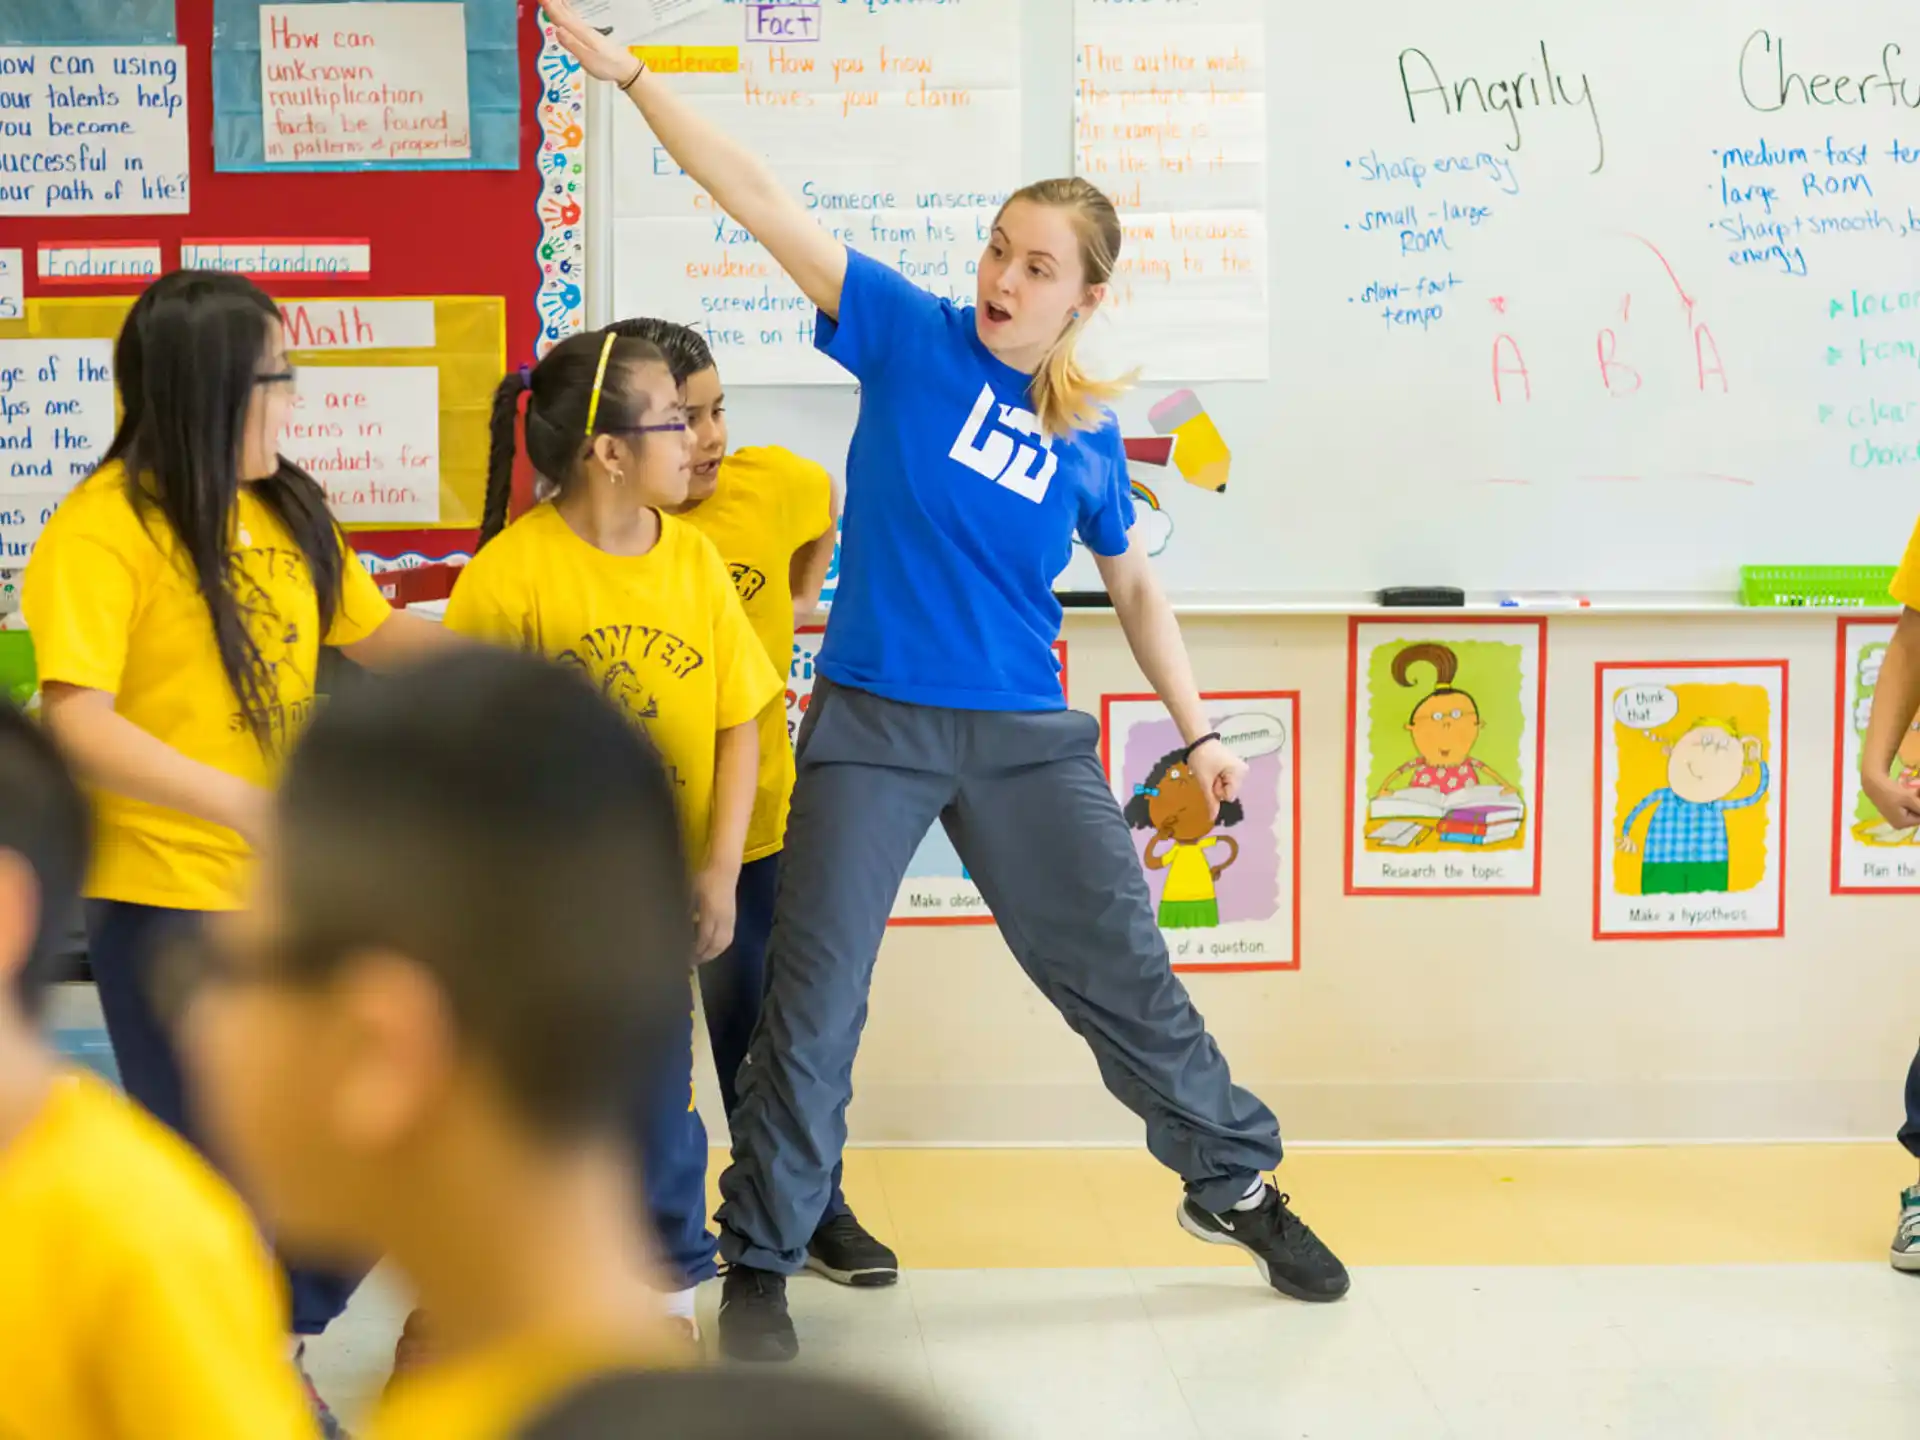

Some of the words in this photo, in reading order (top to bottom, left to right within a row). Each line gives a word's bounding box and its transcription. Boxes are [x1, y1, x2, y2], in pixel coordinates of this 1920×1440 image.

[271, 14, 319, 49] How
[334, 31, 374, 47] can
[757, 6, 812, 35] Fact
[0, 54, 35, 75] ow
[50, 55, 94, 74] can
[113, 57, 177, 84] using
[267, 58, 374, 82] unknown
[769, 45, 815, 73] How
[831, 57, 864, 83] you
[880, 44, 932, 73] know
[1084, 45, 1123, 72] The
[1133, 45, 1196, 72] author
[1739, 29, 1920, 112] Cheerfu
[0, 92, 33, 108] our
[45, 83, 119, 108] talents
[137, 83, 182, 118] help
[268, 83, 423, 115] multiplication
[842, 89, 879, 117] your
[905, 79, 970, 106] claim
[1398, 40, 1604, 174] Angrily
[48, 113, 135, 136] become
[273, 108, 327, 135] facts
[341, 113, 368, 133] be
[384, 106, 448, 131] found
[125, 156, 143, 171] in
[1434, 152, 1520, 195] energy
[0, 184, 35, 200] our
[46, 178, 94, 207] path
[105, 179, 123, 200] of
[142, 172, 188, 200] life?
[802, 181, 895, 210] Someone
[1109, 179, 1141, 207] aid
[1721, 175, 1780, 215] large
[1803, 172, 1873, 197] ROM
[870, 215, 915, 242] from
[926, 216, 955, 242] his
[1400, 226, 1452, 256] ROM
[48, 249, 154, 283] Enduring
[184, 246, 350, 277] Understandings
[685, 250, 768, 278] evidence
[898, 249, 948, 276] found
[1728, 245, 1808, 276] energy
[279, 305, 374, 346] Math
[1382, 304, 1443, 331] tempo
[704, 318, 744, 349] tire
[760, 329, 782, 344] on
[0, 367, 26, 392] ge
[38, 354, 61, 382] of
[78, 357, 110, 382] the
[1492, 333, 1530, 404] A
[1598, 328, 1642, 397] B
[1694, 323, 1728, 393] A
[0, 395, 30, 424] lps
[45, 399, 83, 415] one
[325, 392, 367, 409] are
[0, 425, 32, 449] and
[52, 426, 92, 449] the
[285, 421, 343, 438] terns
[358, 422, 383, 437] in
[11, 458, 53, 477] and
[399, 444, 432, 468] for
[1636, 689, 1664, 706] think
[1382, 862, 1436, 879] Research
[1444, 864, 1464, 879] the
[1863, 861, 1889, 878] Plan
[1897, 861, 1917, 878] the
[910, 893, 942, 908] Make
[949, 893, 987, 908] obser
[1629, 907, 1660, 922] Make
[1198, 943, 1205, 955] a
